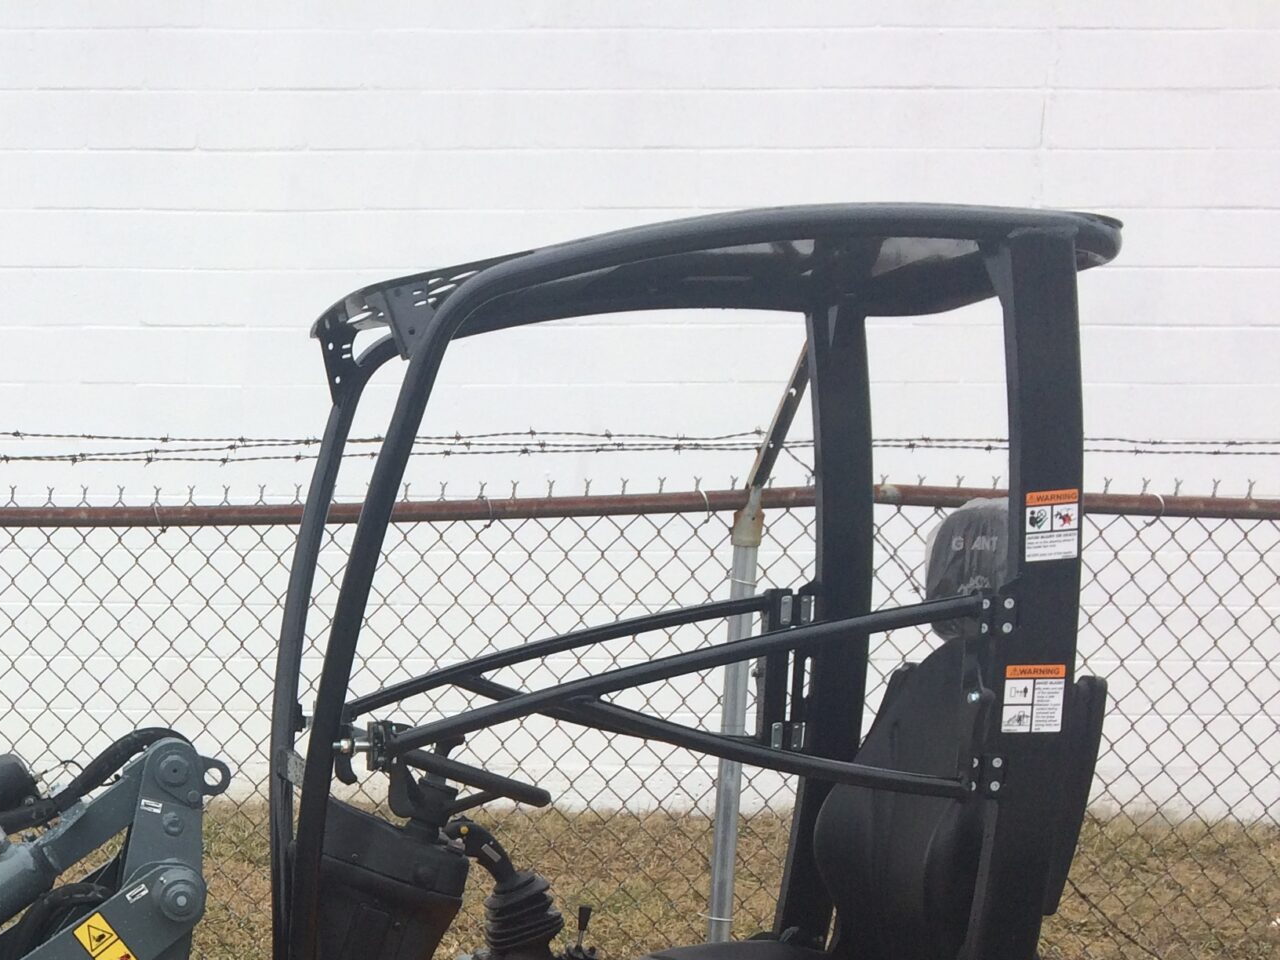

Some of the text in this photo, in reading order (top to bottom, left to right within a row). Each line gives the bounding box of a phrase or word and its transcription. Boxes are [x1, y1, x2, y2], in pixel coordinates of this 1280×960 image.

[1036, 493, 1077, 502] WARNING
[951, 535, 998, 552] GANT
[1020, 667, 1060, 675] WARNING
